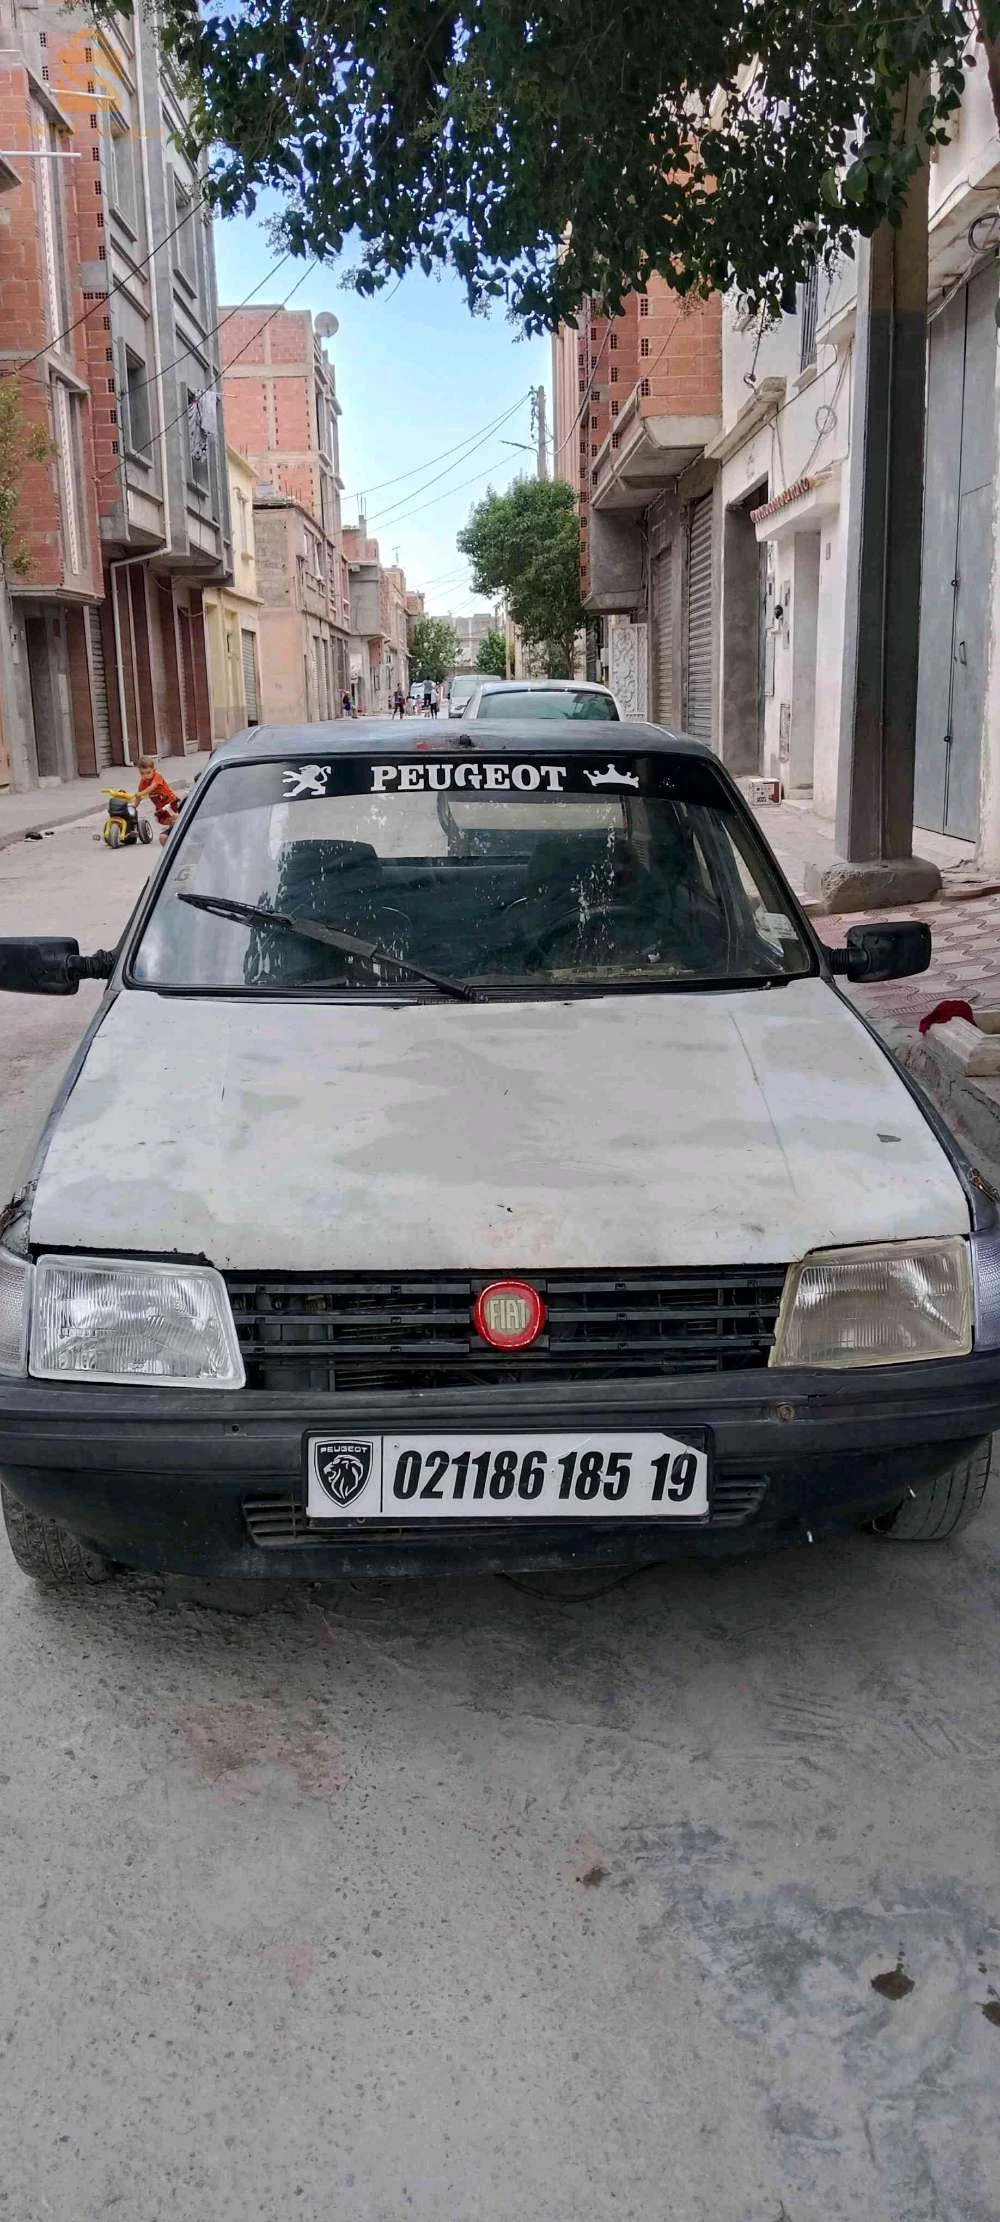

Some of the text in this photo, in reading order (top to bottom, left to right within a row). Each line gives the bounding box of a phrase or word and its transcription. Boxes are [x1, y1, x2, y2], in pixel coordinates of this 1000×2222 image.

[371, 763, 566, 791] PEUGEOT
[489, 1299, 527, 1329] FIAT
[320, 1445, 368, 1453] PEUGEOT
[393, 1450, 698, 1501] 021186 185 19
